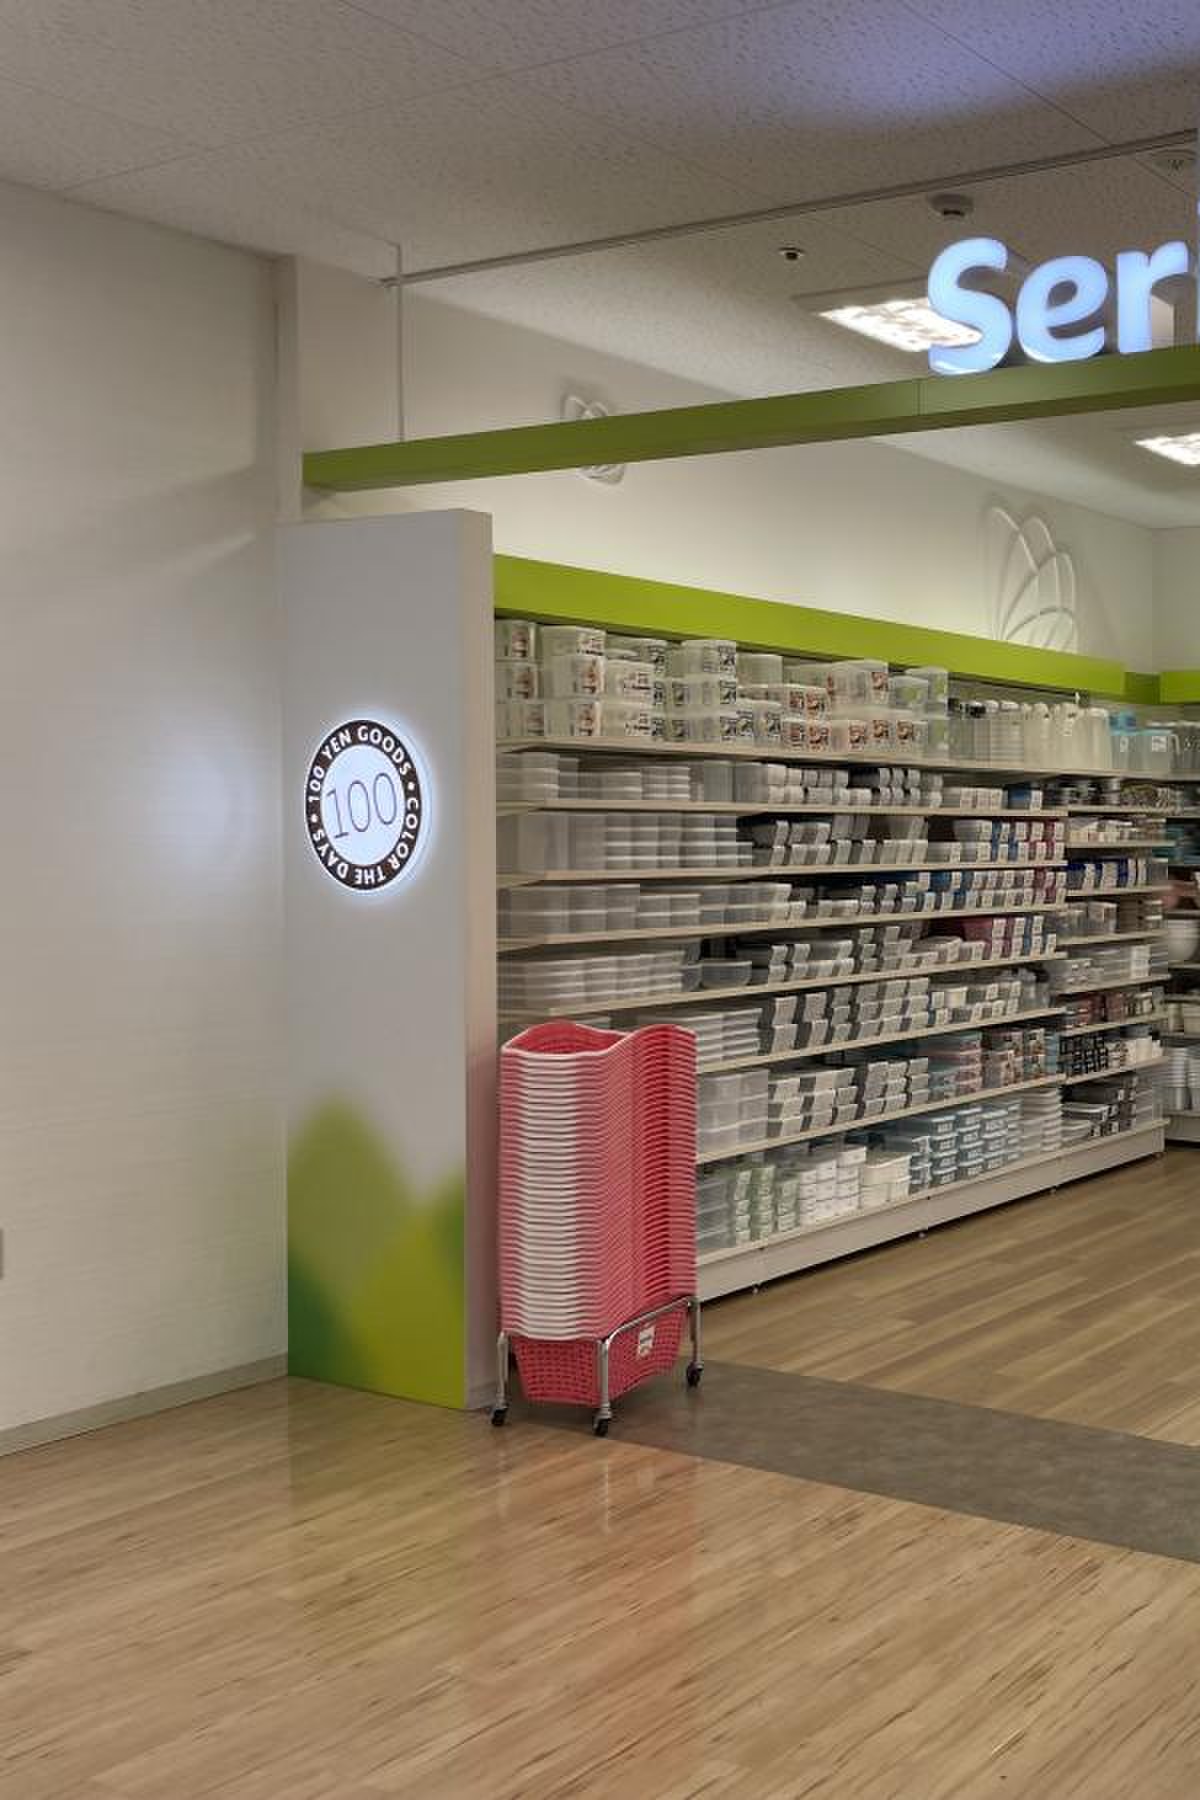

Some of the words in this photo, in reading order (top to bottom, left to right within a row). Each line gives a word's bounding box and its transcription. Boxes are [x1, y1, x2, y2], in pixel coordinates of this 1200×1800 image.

[309, 766, 325, 803] 100
[321, 729, 352, 760] YEN
[358, 726, 411, 775] GOODS
[326, 772, 398, 839] 100
[387, 797, 419, 870] COLOR
[312, 829, 349, 879] DAYS
[354, 867, 386, 885] THE
